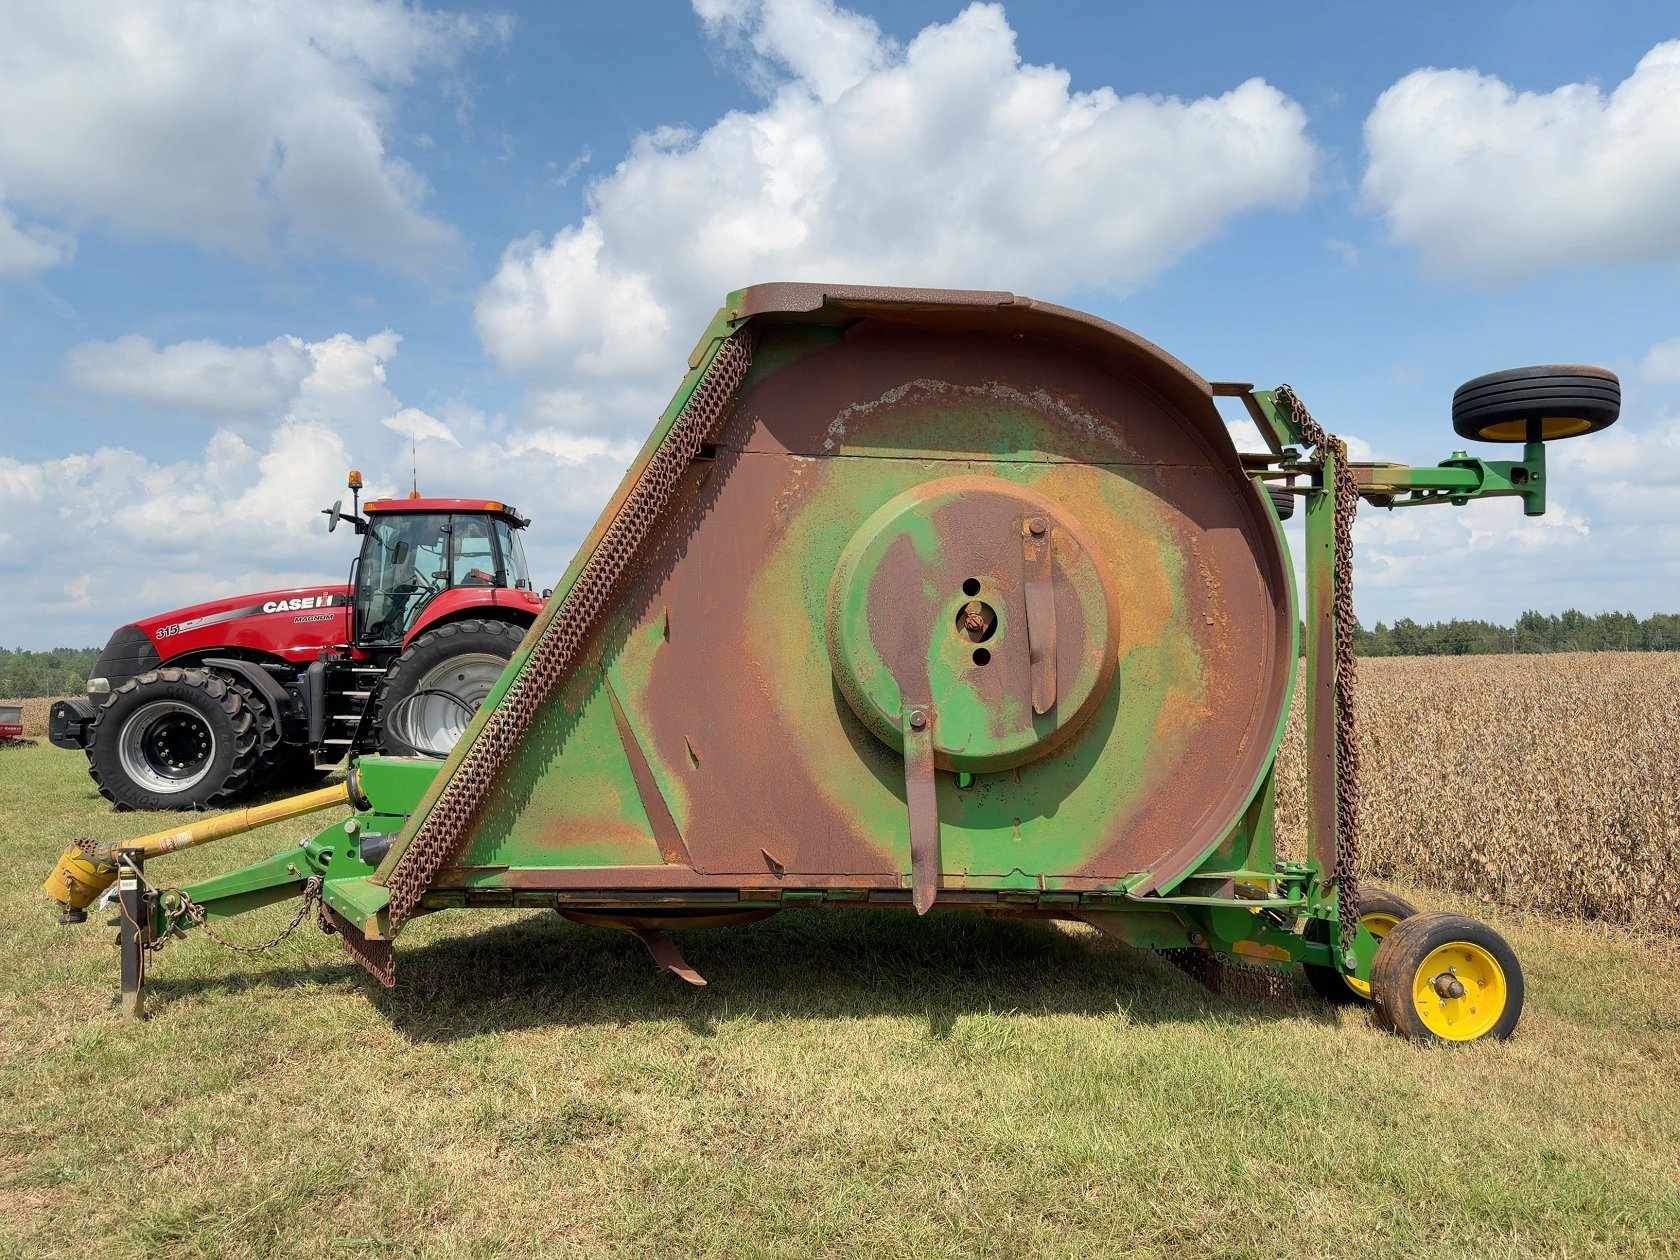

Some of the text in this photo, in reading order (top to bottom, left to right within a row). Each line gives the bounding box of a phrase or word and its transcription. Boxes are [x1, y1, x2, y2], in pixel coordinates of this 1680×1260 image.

[263, 597, 315, 614] CASE
[294, 614, 334, 623] MAGNUM
[156, 624, 178, 639] 315
